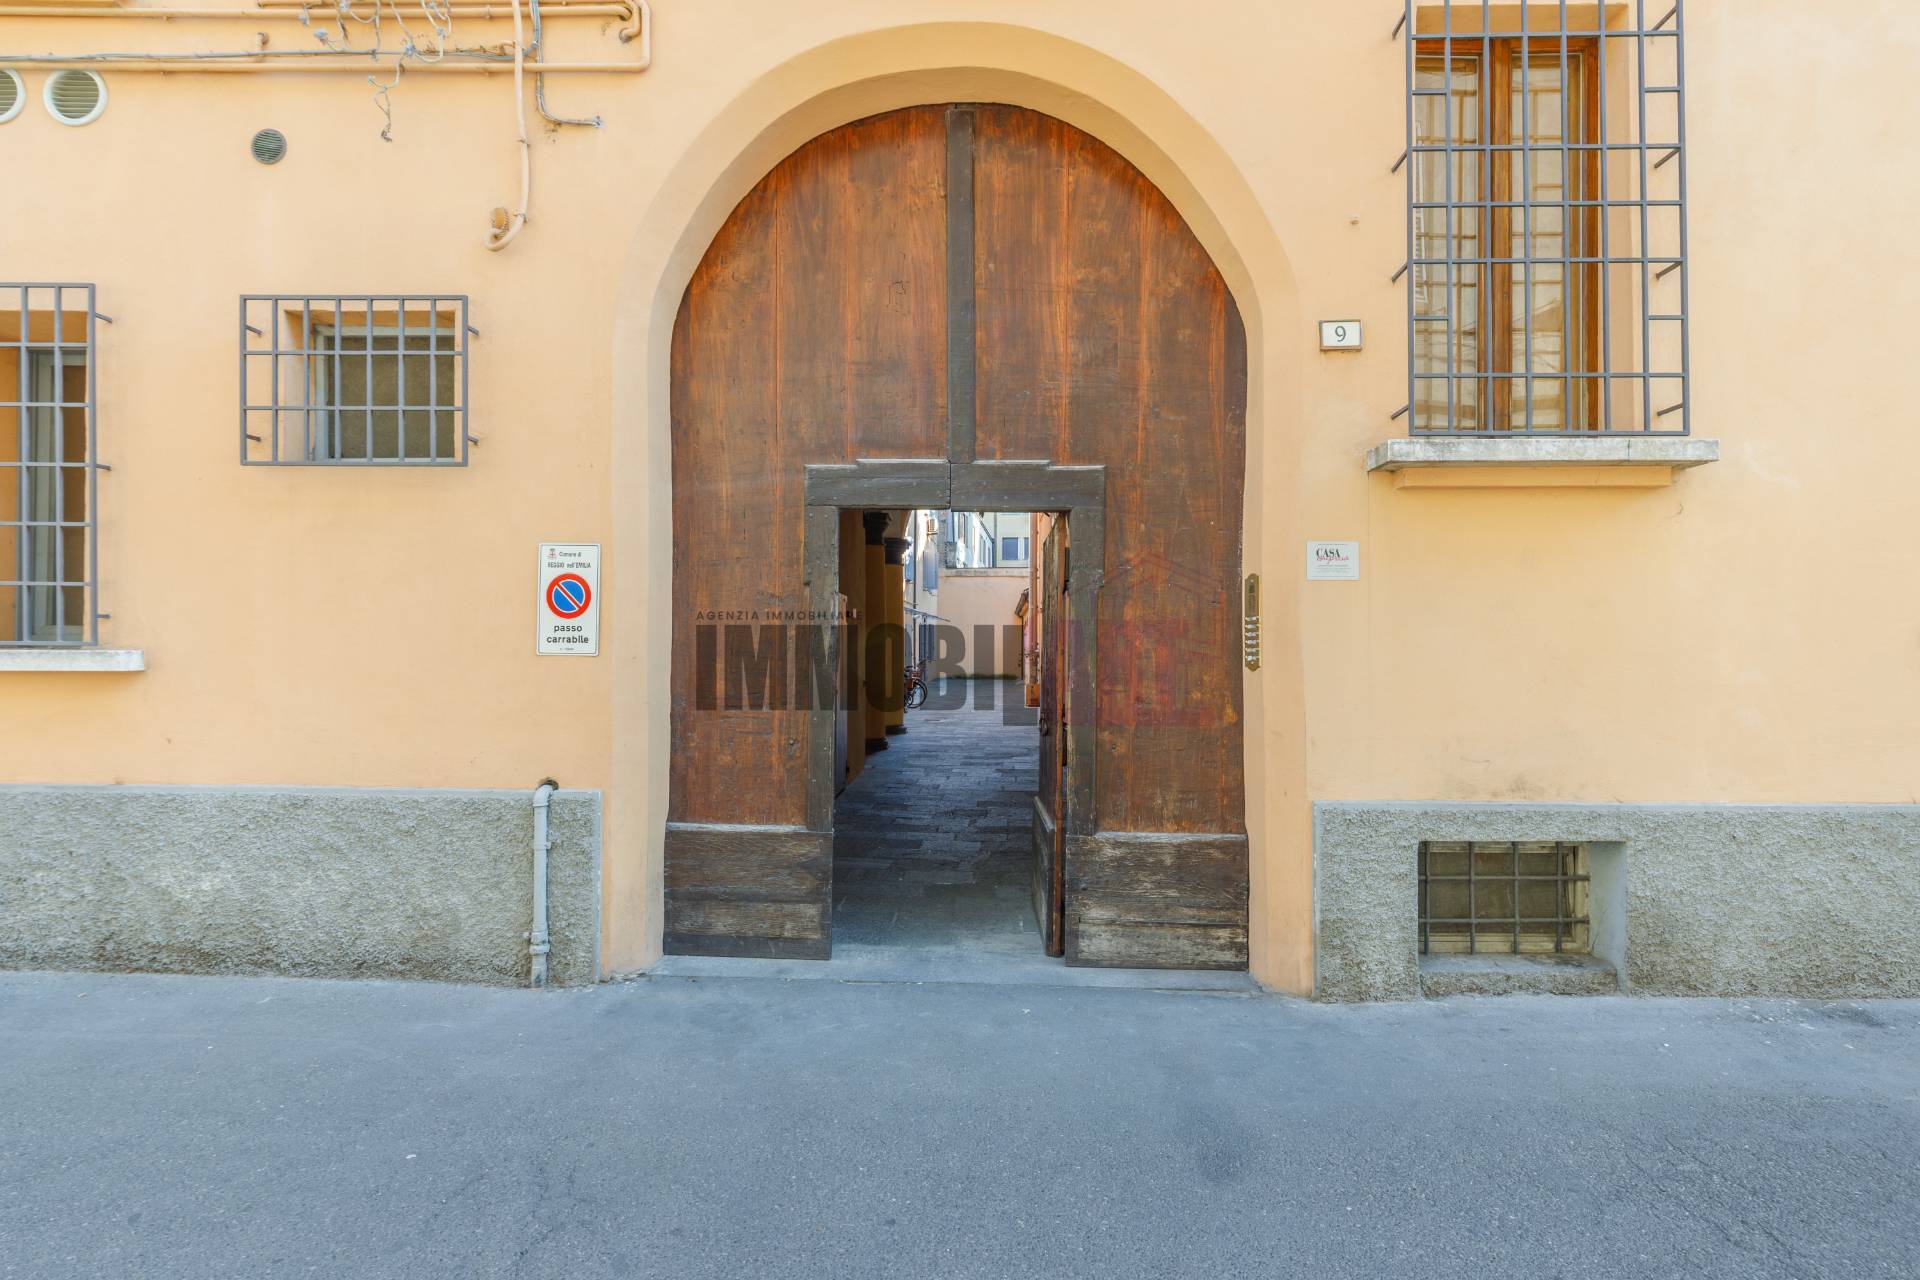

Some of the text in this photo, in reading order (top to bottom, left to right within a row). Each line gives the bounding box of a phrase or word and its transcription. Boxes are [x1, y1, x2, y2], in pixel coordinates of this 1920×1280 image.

[1334, 325, 1347, 342] 9
[1316, 548, 1340, 558] CASA
[554, 625, 583, 633] passo
[546, 635, 589, 644] carrabile
